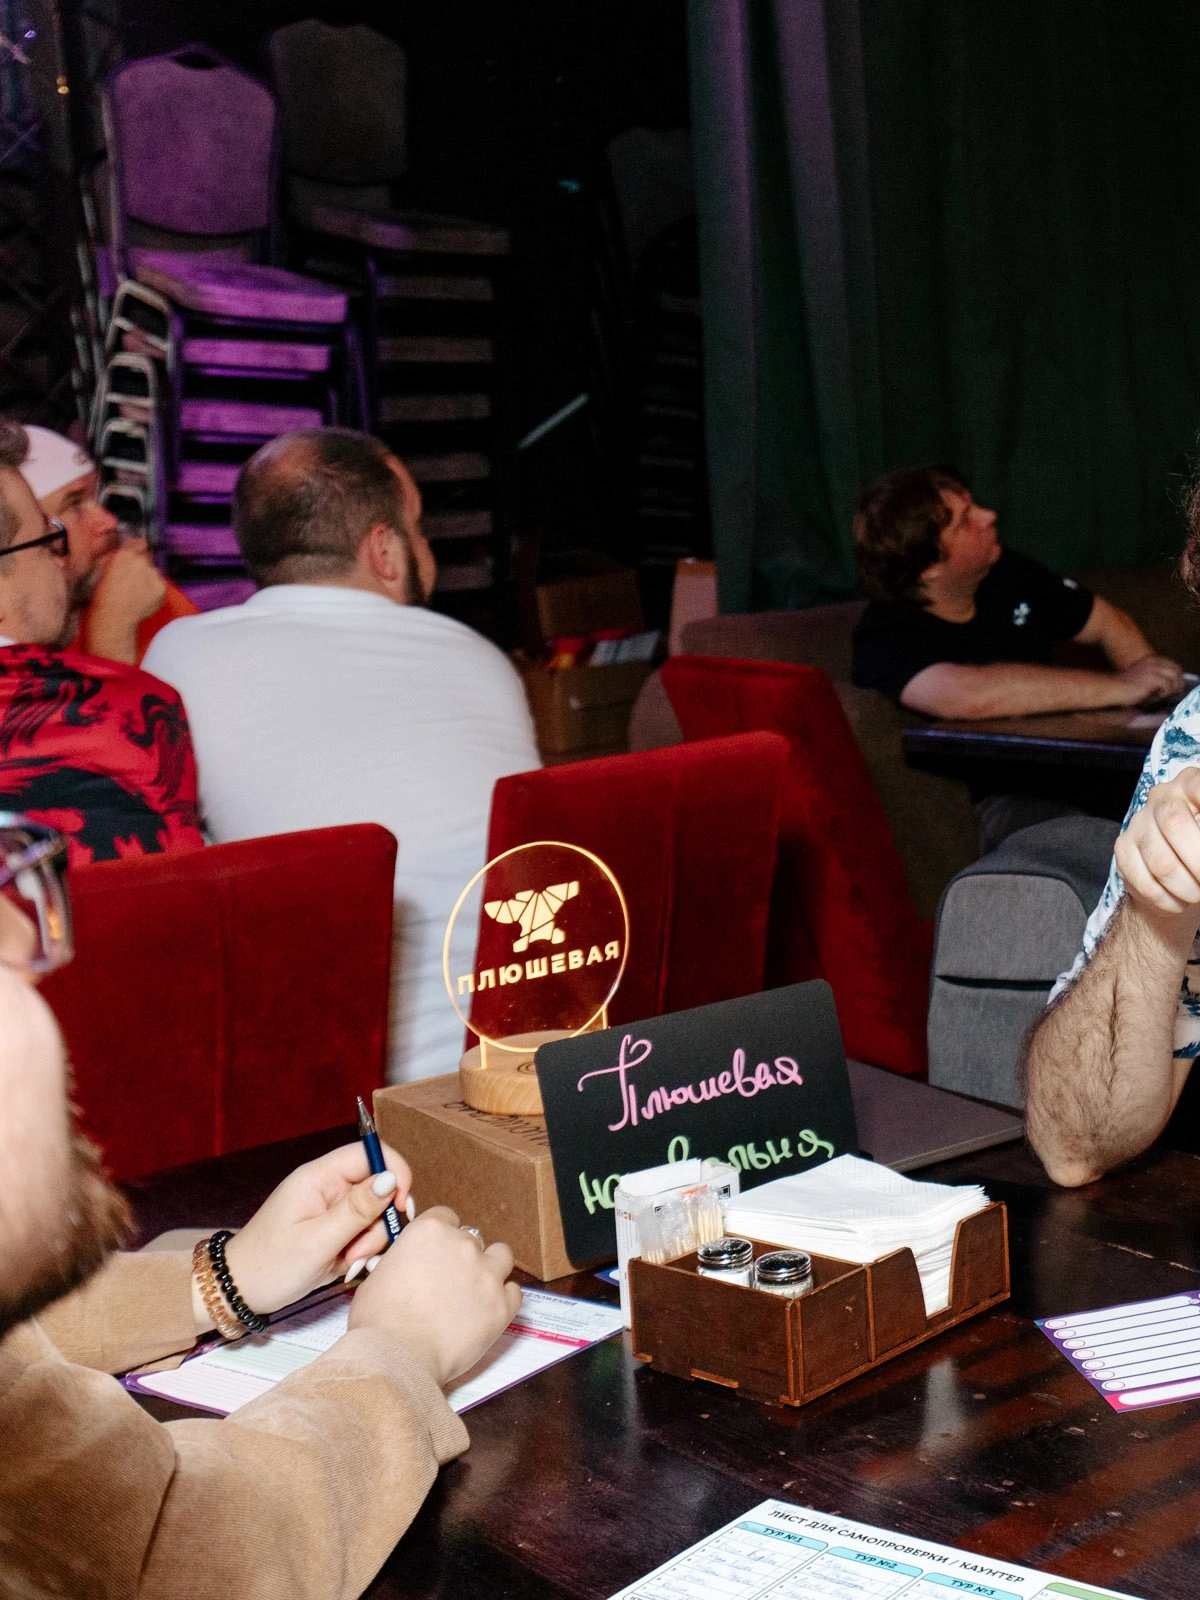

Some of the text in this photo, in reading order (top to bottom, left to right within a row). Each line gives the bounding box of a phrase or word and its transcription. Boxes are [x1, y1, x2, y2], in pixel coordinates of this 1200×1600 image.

[457, 940, 621, 996] ПЛЮШЕВАЯ
[577, 1034, 804, 1131] Плюшевая
[385, 1205, 401, 1235] КВИЗ
[761, 1527, 803, 1545] ТУР №1
[767, 1509, 809, 1528] ЛИСТ
[807, 1520, 837, 1533] ДЛЯ
[837, 1529, 951, 1566] САМОПРОВЕРКИ
[959, 1561, 1026, 1584] КАУНТЕР
[853, 1552, 898, 1570] ТУР №2
[950, 1579, 996, 1597] ТУР №3
